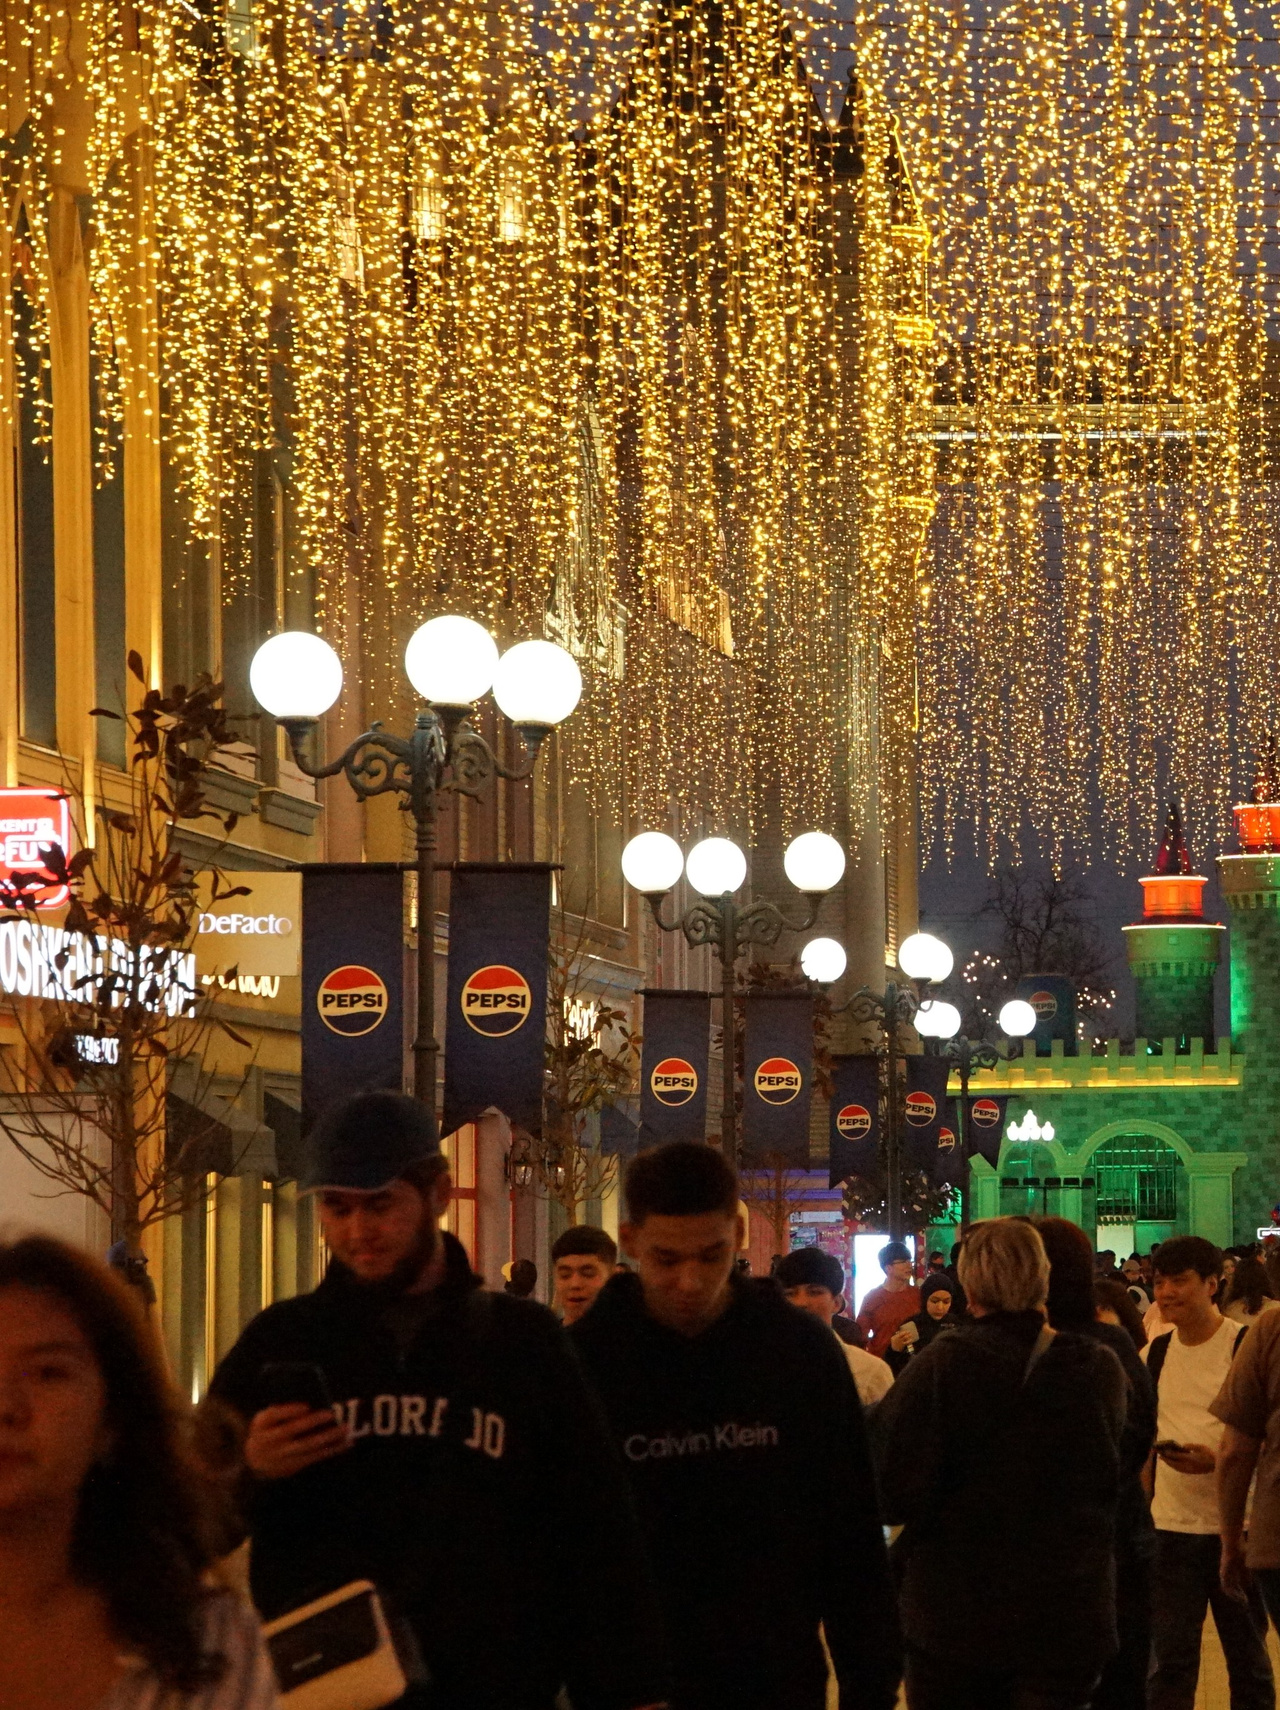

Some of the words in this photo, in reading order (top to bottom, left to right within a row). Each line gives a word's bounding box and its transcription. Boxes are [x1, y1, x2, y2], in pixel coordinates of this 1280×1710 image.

[198, 913, 292, 935] DeFacto
[322, 993, 383, 1008] PEPSI
[466, 993, 526, 1008] PEPSI
[654, 1076, 694, 1088] PEPSI
[757, 1075, 798, 1086] PEPSI
[905, 1103, 934, 1114] PEPSI
[973, 1108, 998, 1119] PEPSI
[839, 1118, 869, 1126] PEPSI
[624, 1430, 709, 1461] Calvin
[714, 1421, 779, 1449] Klein
